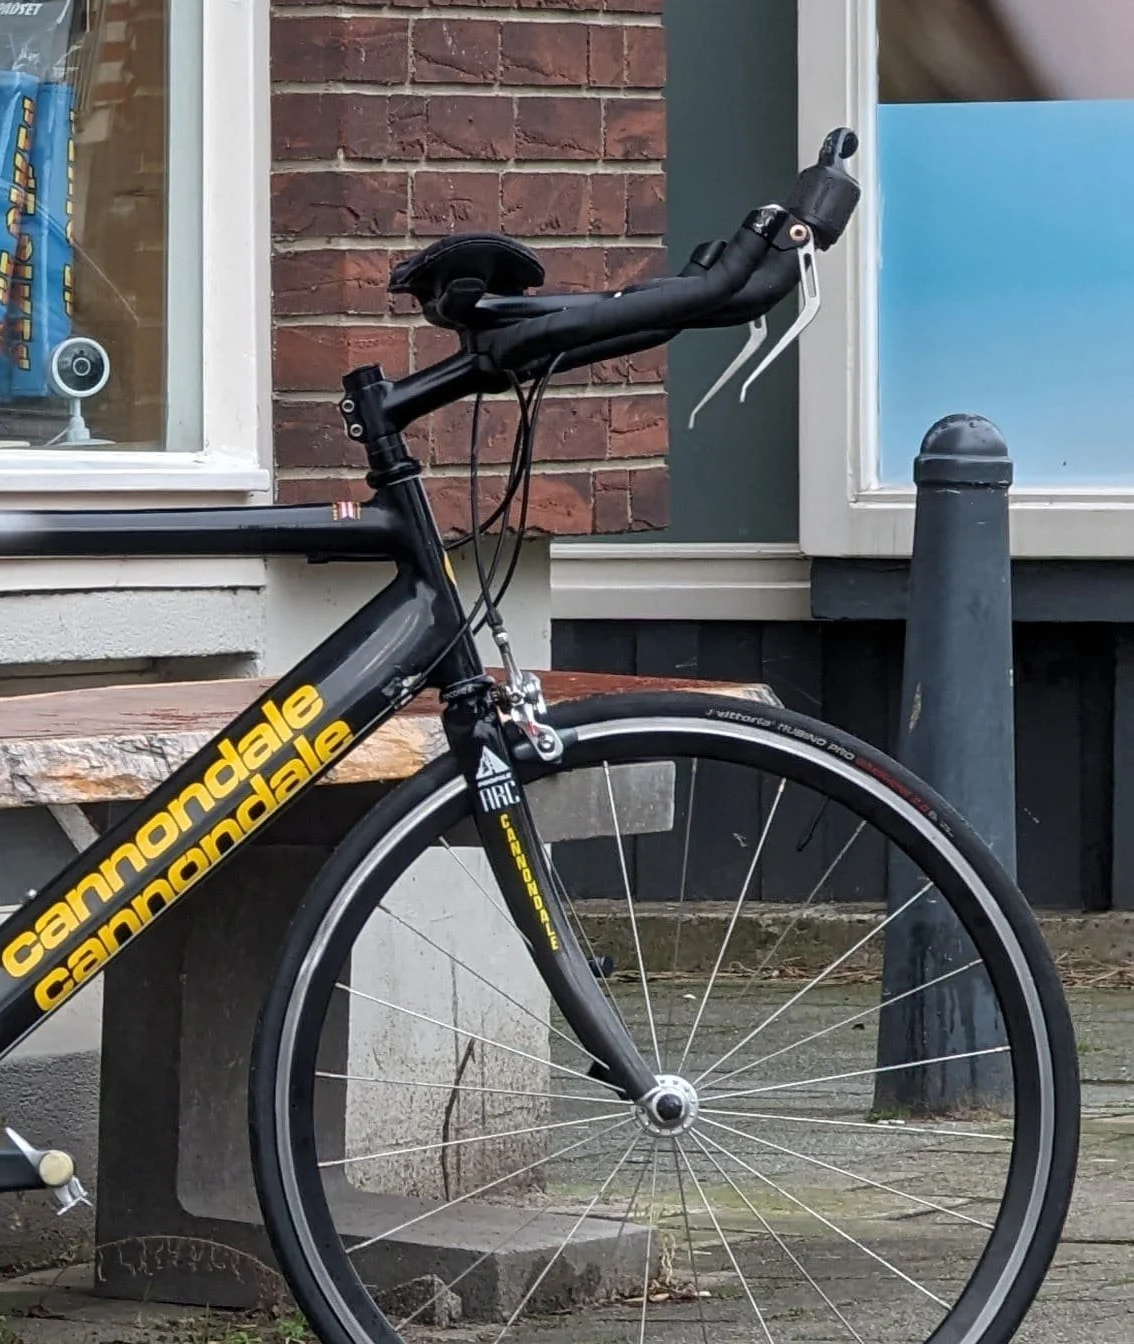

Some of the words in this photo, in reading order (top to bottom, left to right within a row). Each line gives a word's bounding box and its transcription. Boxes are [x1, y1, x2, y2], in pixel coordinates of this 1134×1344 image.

[478, 779, 521, 813] ARC
[827, 742, 855, 762] PRO
[1, 683, 325, 979] cannondale
[33, 719, 355, 1013] cannondale
[500, 812, 560, 951] CANNONDALE
